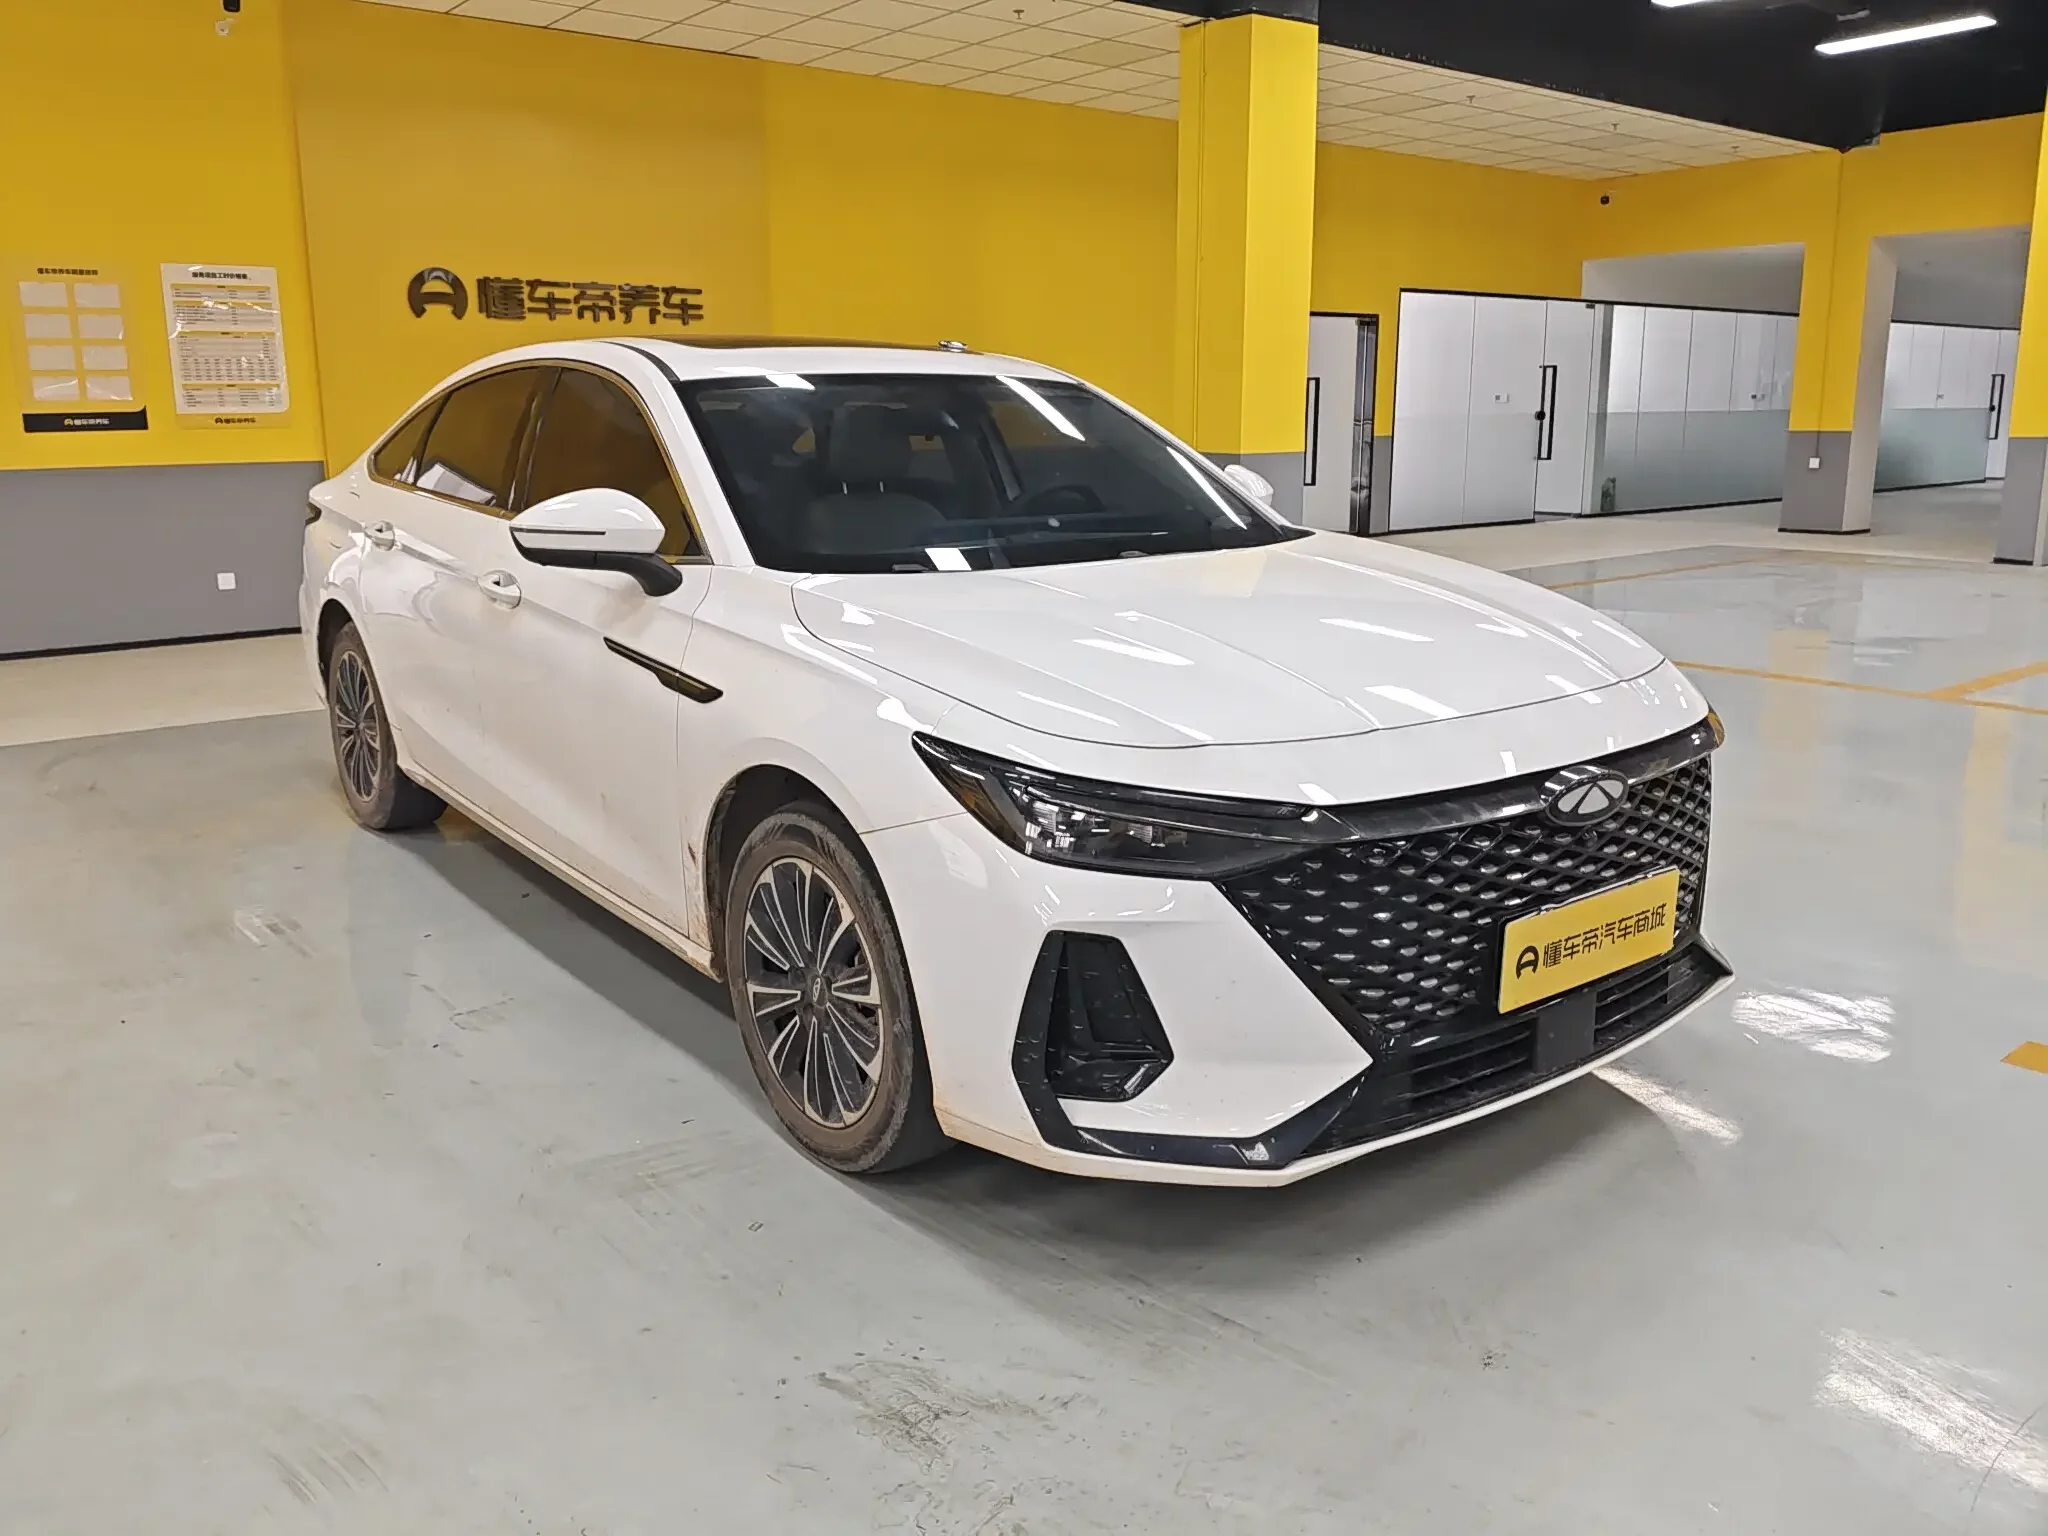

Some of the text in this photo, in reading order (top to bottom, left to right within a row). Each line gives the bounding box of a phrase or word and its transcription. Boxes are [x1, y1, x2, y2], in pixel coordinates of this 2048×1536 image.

[476, 277, 704, 325] 懂车帝养车
[1543, 903, 1667, 968] 懂车帝汽车商城
